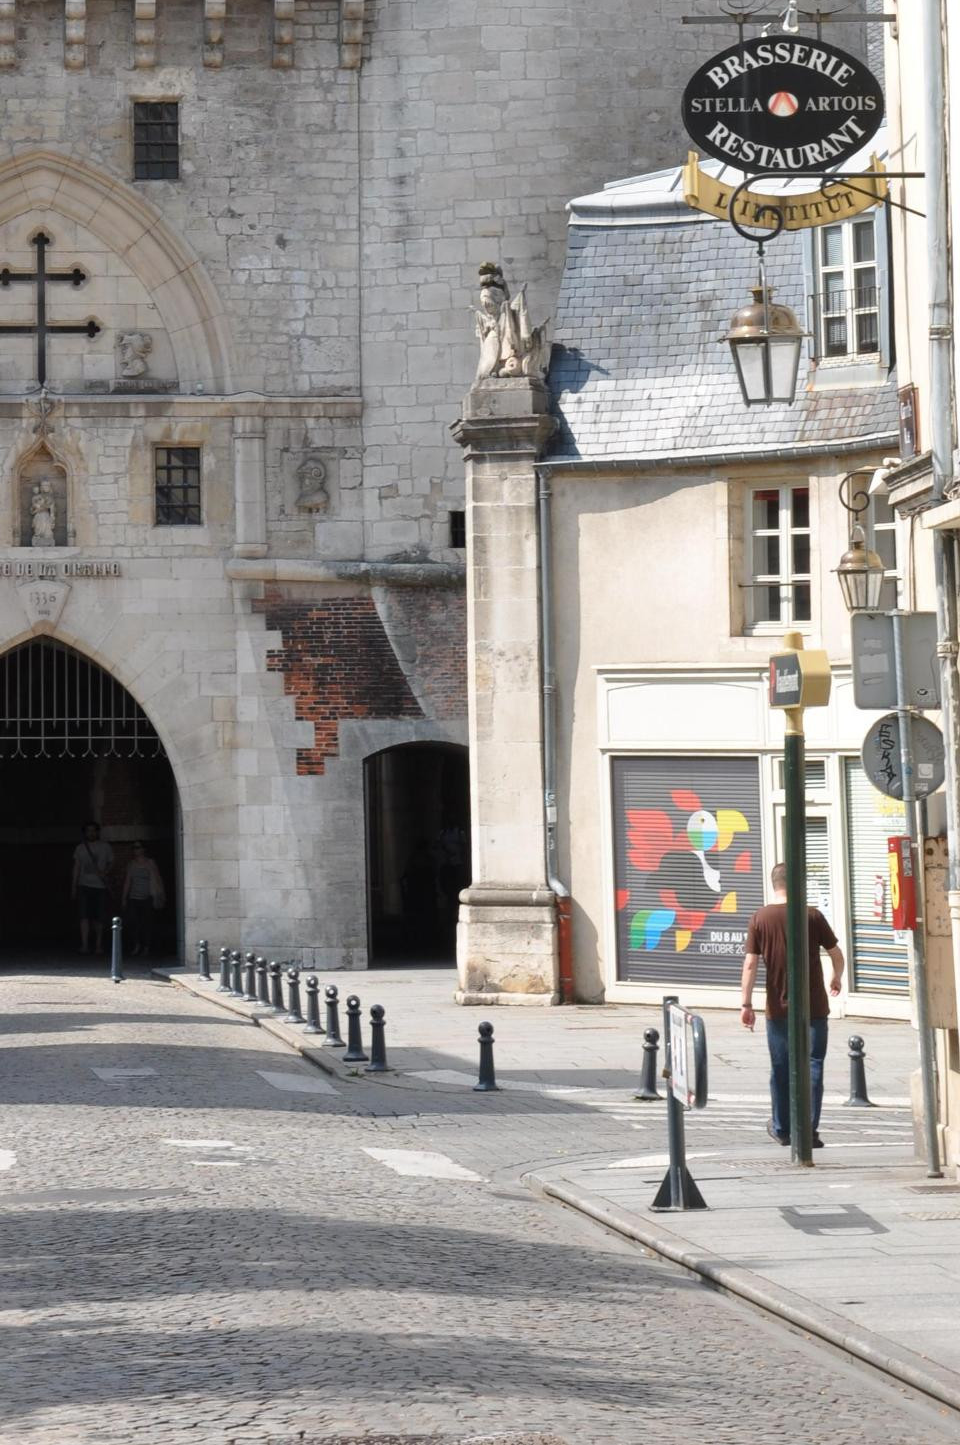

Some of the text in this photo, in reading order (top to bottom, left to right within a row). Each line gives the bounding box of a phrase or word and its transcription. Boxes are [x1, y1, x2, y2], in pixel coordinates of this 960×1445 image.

[706, 42, 856, 90] BRASSERIE
[691, 96, 877, 113] STELLA ARTOIS
[705, 116, 867, 169] RESTAURANT
[710, 931, 723, 942] DU
[731, 932, 743, 942] AU
[700, 943, 735, 954] OCTOBRE
